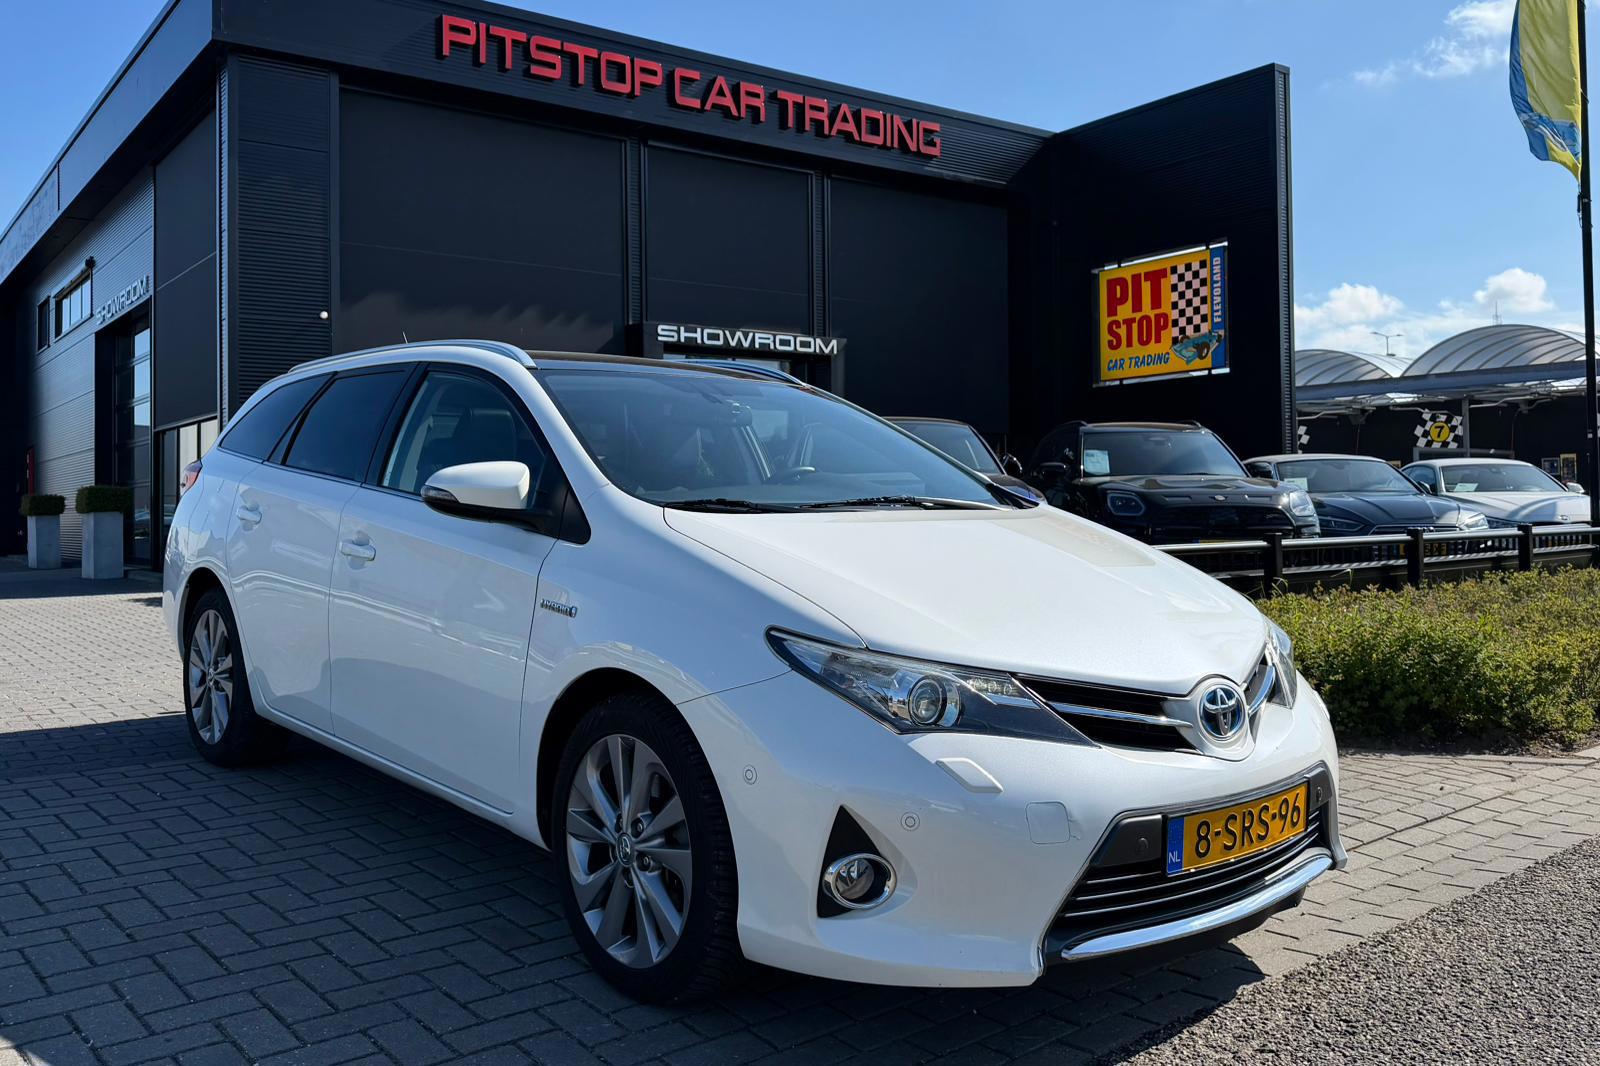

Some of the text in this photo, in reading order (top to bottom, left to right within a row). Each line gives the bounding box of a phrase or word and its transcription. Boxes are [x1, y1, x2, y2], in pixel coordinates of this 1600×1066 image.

[441, 13, 941, 157] PITSTOP CAR TRADING
[1106, 267, 1168, 318] PIT
[1213, 256, 1222, 323] FLEVOLAND
[657, 324, 838, 355] SHOWROOM
[1107, 312, 1169, 351] STOP
[1107, 352, 1170, 371] CAR TRADING
[1434, 425, 1446, 439] 7
[1195, 792, 1301, 858] 8-SRS-96
[1168, 851, 1181, 864] NL
